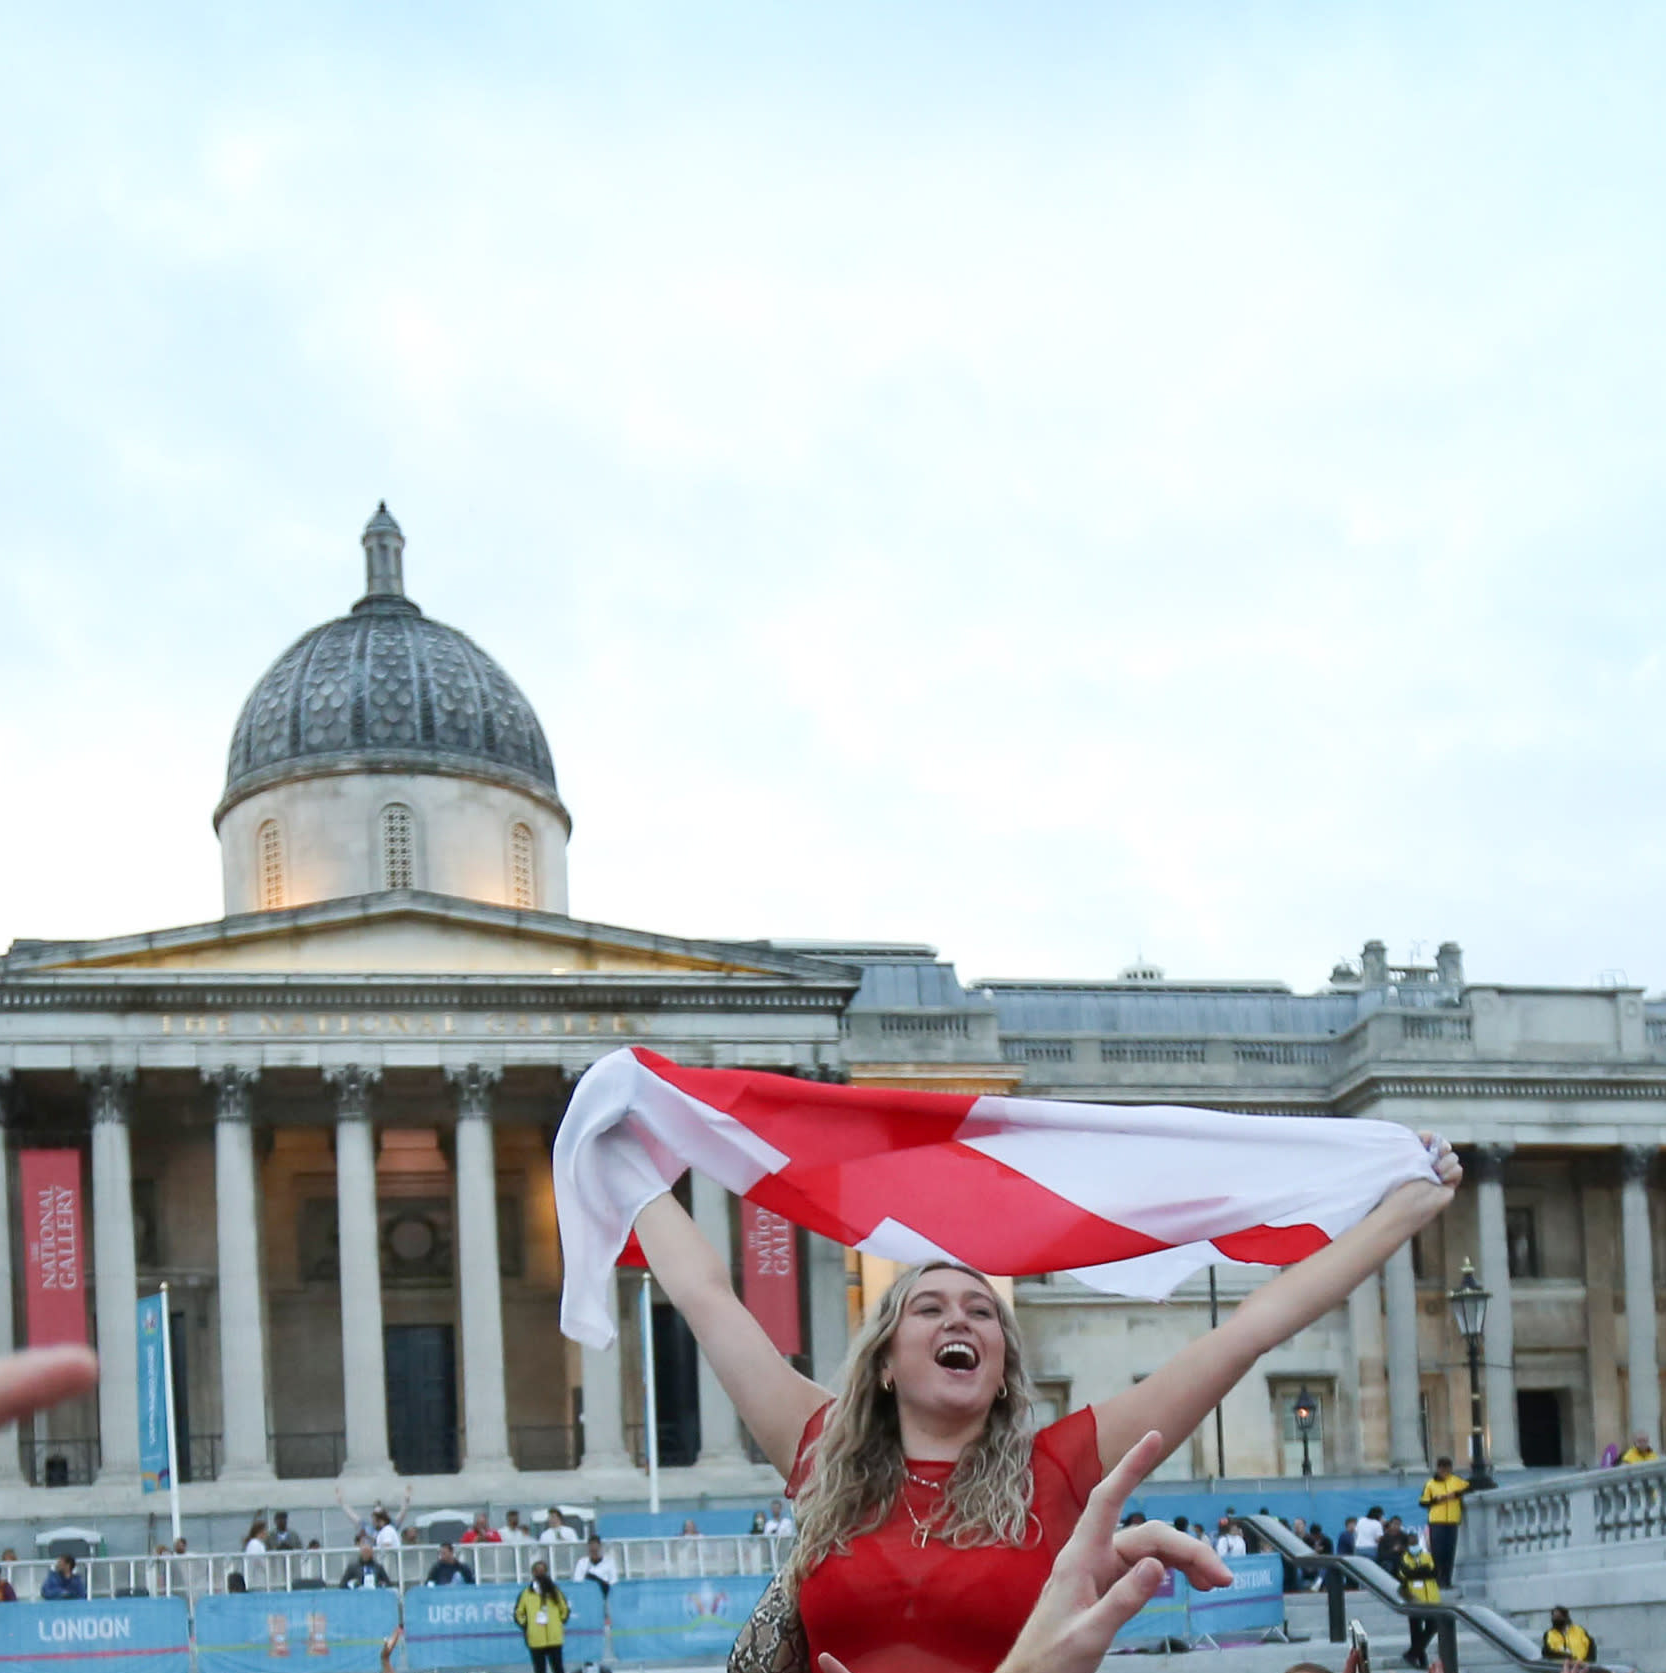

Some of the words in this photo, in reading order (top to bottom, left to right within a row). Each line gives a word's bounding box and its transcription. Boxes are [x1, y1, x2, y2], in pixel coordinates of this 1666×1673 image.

[162, 1014, 230, 1034] THE
[259, 1013, 454, 1034] NATIONAL
[484, 1012, 652, 1034] GALLERY
[38, 1184, 57, 1290] NATIONAL
[55, 1185, 77, 1291] GALLERY
[772, 1214, 789, 1276] GALL
[38, 1616, 131, 1643] LONDON
[428, 1604, 478, 1624] UEFA
